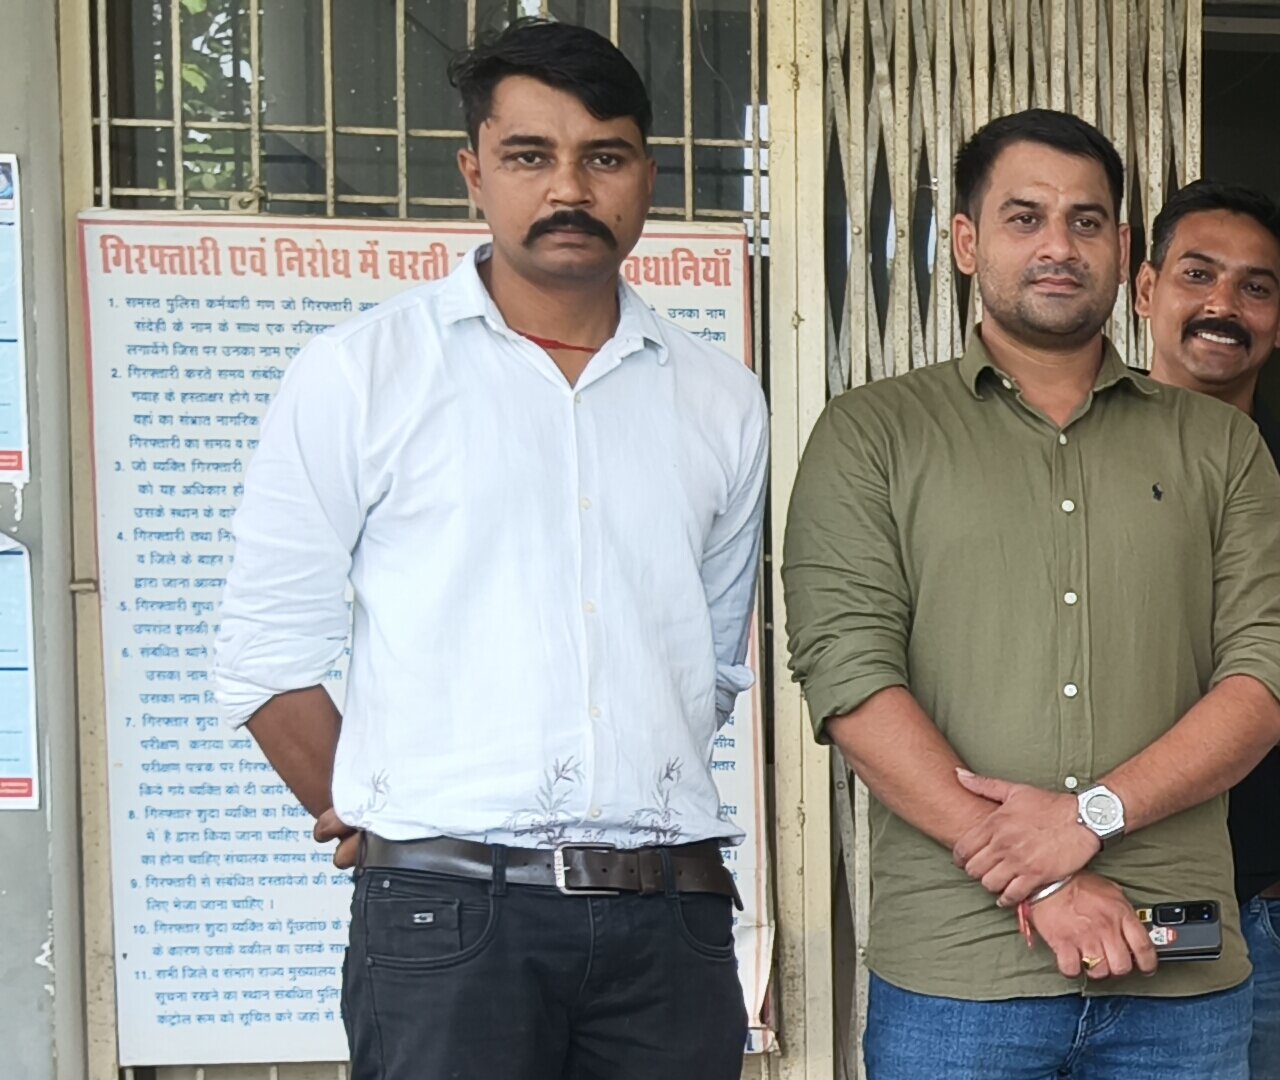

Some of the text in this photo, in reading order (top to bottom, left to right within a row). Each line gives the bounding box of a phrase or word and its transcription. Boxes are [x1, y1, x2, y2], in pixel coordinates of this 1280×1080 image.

[100, 234, 732, 287] गिरफ्तारी एवं निरोध में बरती वधानियाँ
[166, 294, 200, 313] पुलिस
[206, 296, 249, 310] कर्मचारी
[302, 296, 352, 312] गिरफ्तारी
[667, 308, 699, 319] उनका
[706, 308, 725, 319] नाम
[173, 342, 280, 357] जिस पर उनका नाम
[129, 434, 180, 449] गिरफ्तारी
[184, 439, 200, 449] का
[191, 459, 242, 473] गिरफ्तारी
[182, 481, 227, 496] अधिकार
[142, 713, 189, 727] गिरफ्तार
[145, 874, 197, 888] गिरफ्तारी
[146, 897, 169, 912] लिए
[155, 920, 200, 935] गिरफ्तार
[288, 966, 336, 981] मुख्यालय
